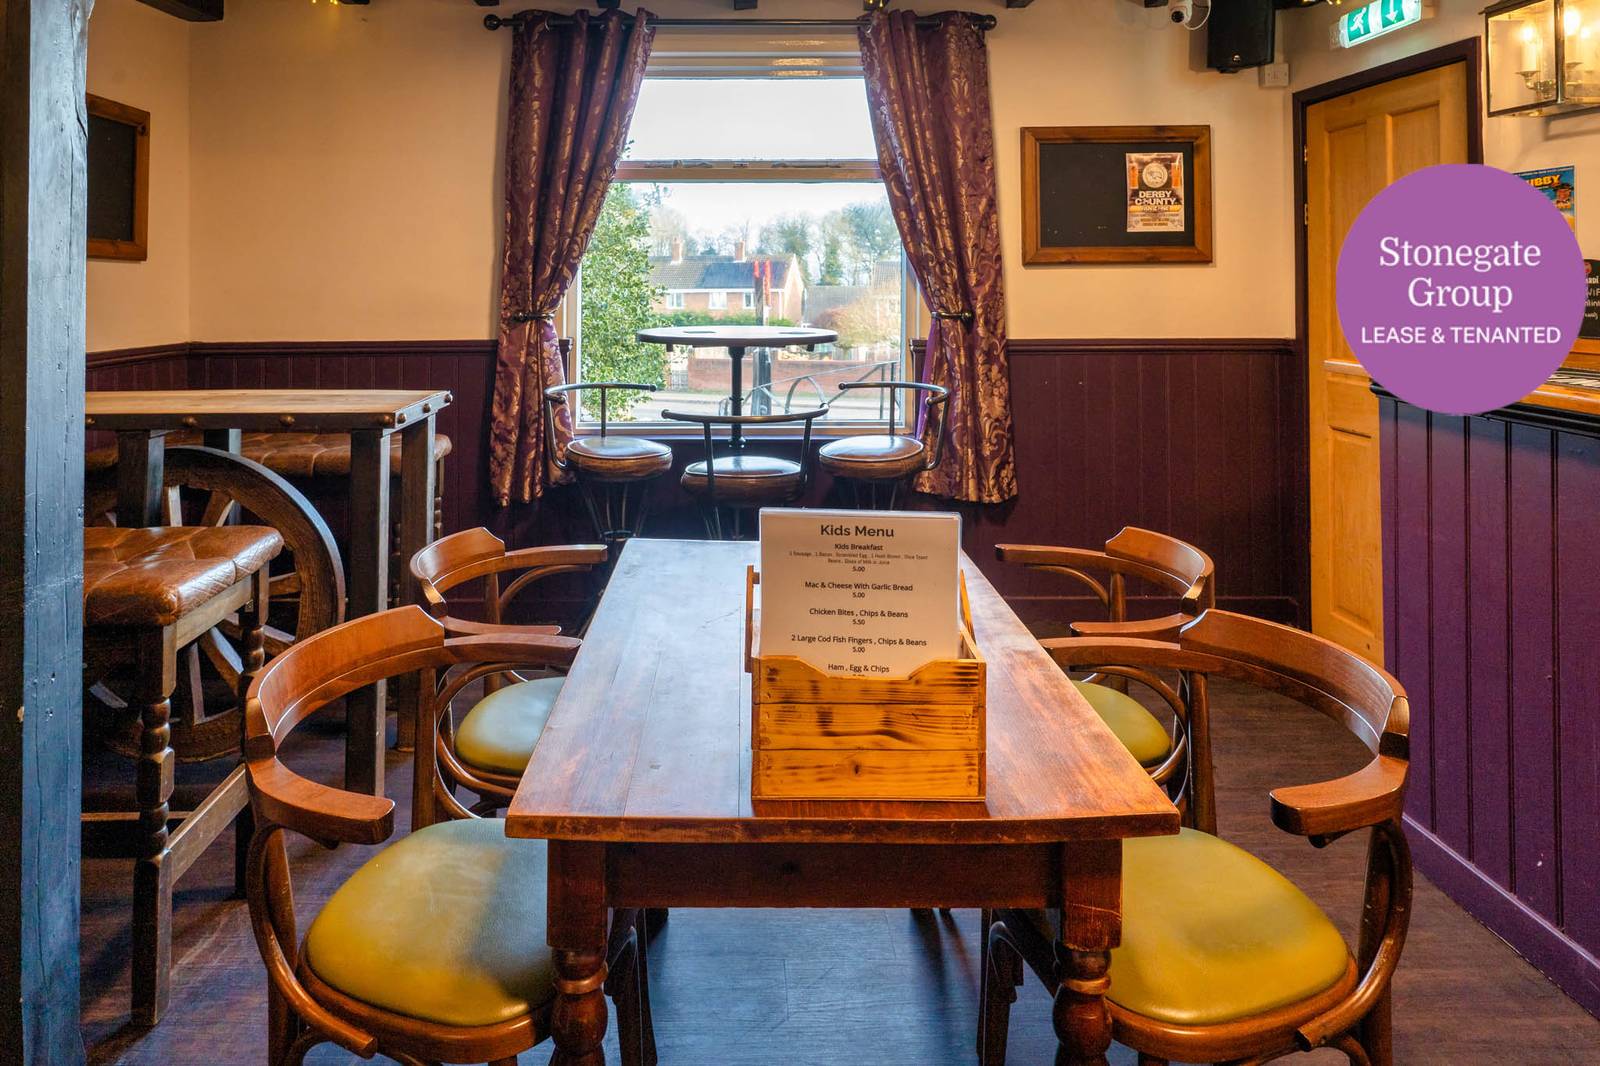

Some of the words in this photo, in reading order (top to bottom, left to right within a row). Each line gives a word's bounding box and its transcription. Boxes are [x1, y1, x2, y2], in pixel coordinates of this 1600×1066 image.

[1139, 190, 1172, 198] DERBY
[820, 525, 850, 536] Kids
[855, 525, 894, 537] Menu
[828, 582, 852, 590] Cheese
[872, 583, 892, 591] Garlic
[809, 608, 836, 616] Chicken
[838, 608, 854, 616] Bites
[860, 610, 878, 618] Chips
[888, 610, 908, 618] Beans
[797, 634, 816, 644] Large
[818, 635, 832, 643] Cod
[848, 636, 872, 646] Fingers
[878, 638, 898, 647] Chips
[906, 638, 927, 646] Beans
[850, 664, 862, 673] Egg
[870, 665, 890, 673] Chips
